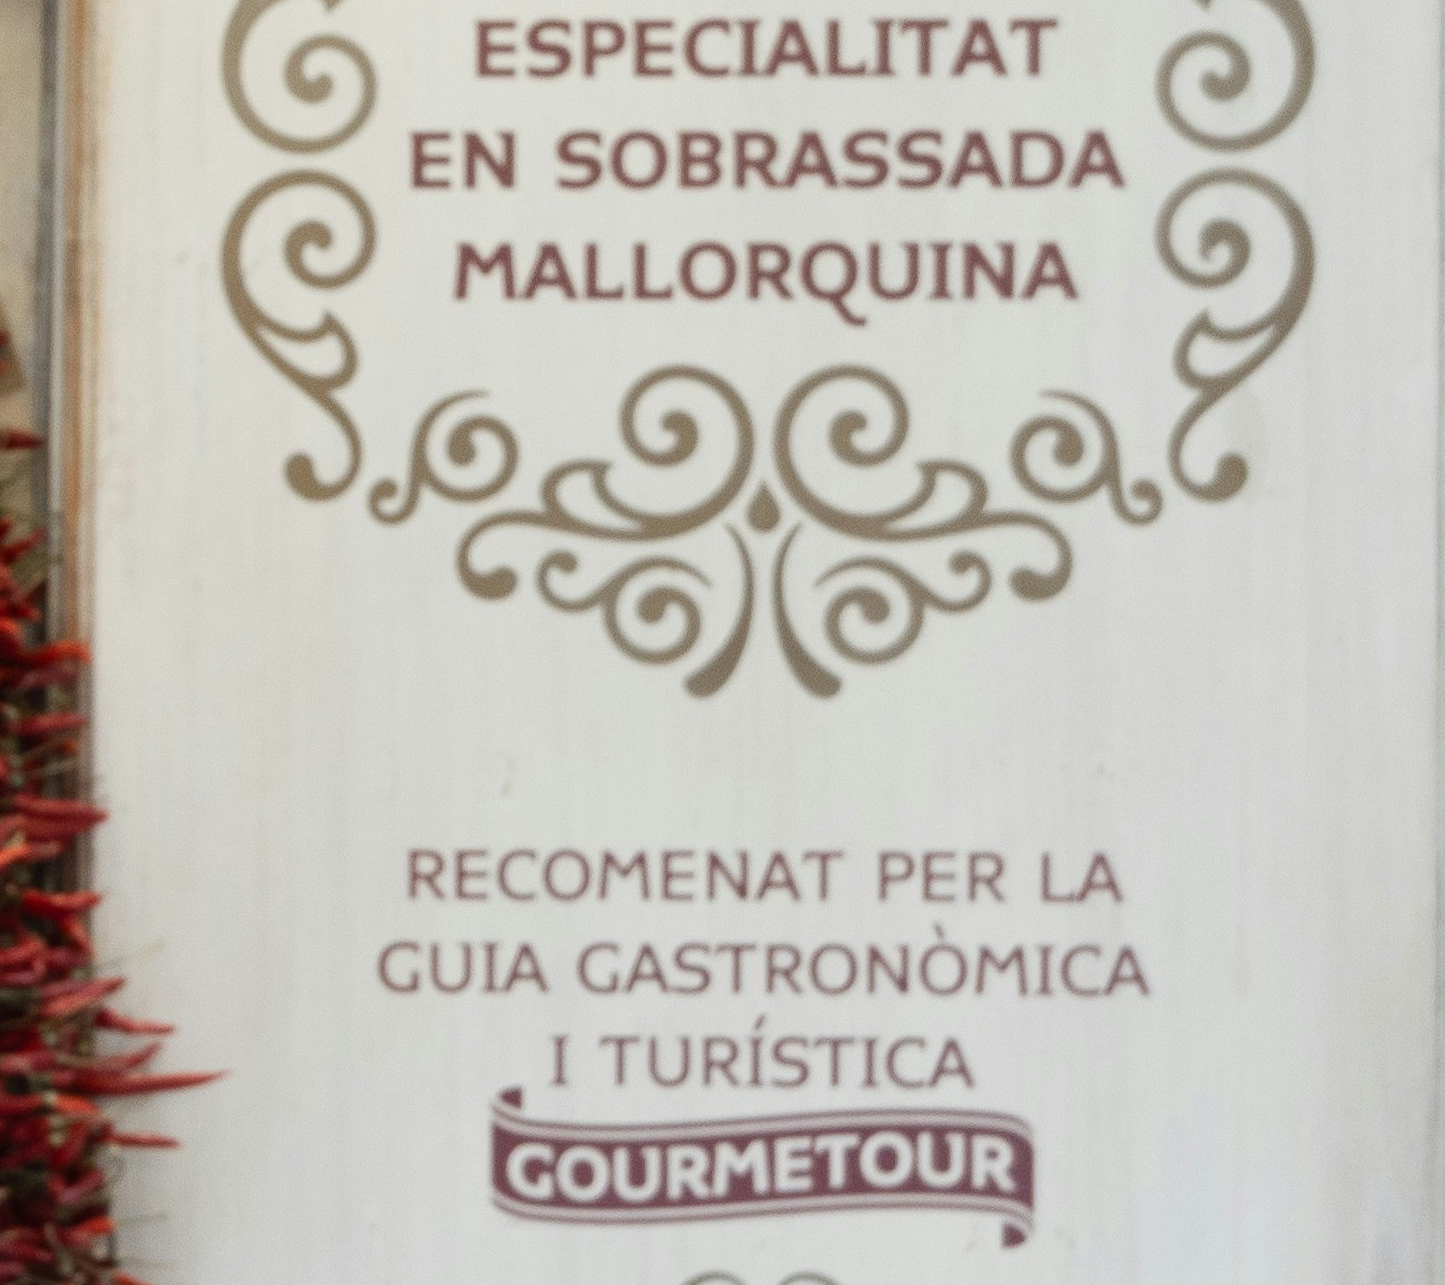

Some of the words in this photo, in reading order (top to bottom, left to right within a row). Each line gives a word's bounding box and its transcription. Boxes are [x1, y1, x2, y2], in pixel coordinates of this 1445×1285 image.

[475, 17, 1059, 80] ESPECIALITAT
[410, 130, 516, 190] EN
[555, 129, 1126, 191] SOBRASSADA
[453, 241, 1079, 328] MALLORQUINA
[407, 849, 844, 902] RECOMENAT
[877, 851, 1006, 903] PER
[1040, 852, 1124, 904] LA
[376, 942, 550, 995] GUIA
[575, 924, 1151, 998] GASTRONÒMICA
[550, 1036, 569, 1087] I
[598, 1016, 976, 1091] TURÍSTICA
[503, 1124, 1020, 1204] GOURMETOUR
